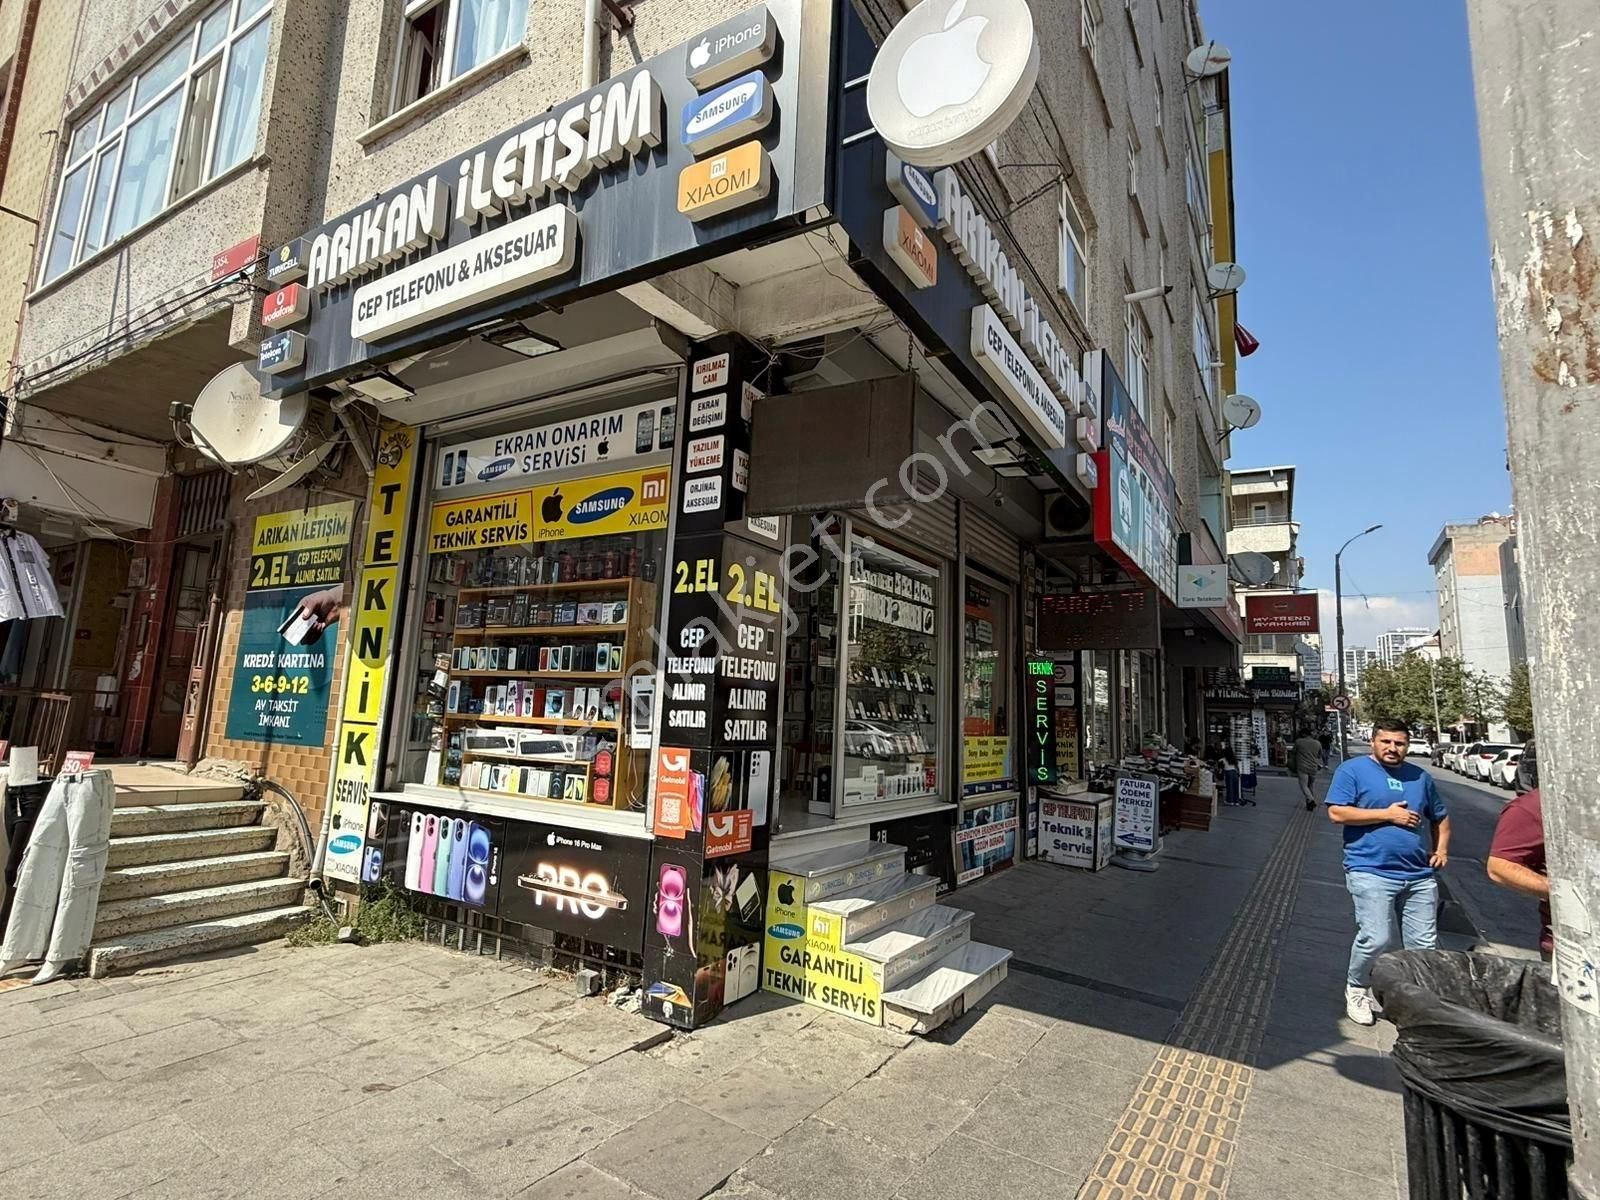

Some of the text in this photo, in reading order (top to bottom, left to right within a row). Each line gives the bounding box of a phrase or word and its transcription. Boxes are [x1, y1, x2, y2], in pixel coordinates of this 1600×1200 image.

[714, 22, 762, 53] iPhone
[694, 89, 749, 124] SAMSUNG
[685, 168, 752, 208] XIAOMI
[307, 175, 439, 289] ARIKAN
[902, 231, 935, 282] XIAOMI
[269, 256, 299, 278] TURKCELL
[357, 223, 558, 322] CEP TELEFONU & AKSESUAR
[263, 304, 295, 324] vodafone
[695, 358, 726, 375] KIRILMAZ
[987, 324, 1003, 356] CEP
[1003, 343, 1035, 400] TELEFONU
[702, 373, 718, 385] CAM
[697, 398, 720, 412] EKRAN
[692, 411, 723, 427] DEĞİŞİMİ
[495, 413, 624, 457] EKRAN ONARIM
[692, 439, 720, 454] YAZILIM
[689, 454, 721, 468] YÜKLEME
[575, 496, 626, 515] SAMSUNG
[686, 495, 719, 509] AKSESUAR
[445, 497, 518, 527] GARANTİLİ
[628, 509, 669, 527] XIAOM
[257, 514, 348, 548] ARIKAN İLETİŞİM
[433, 519, 528, 550] TEKNİK SERVİS
[538, 526, 565, 539] iPhone
[297, 546, 343, 566] CEP TELEFONU
[251, 554, 291, 588] 2.EL
[294, 566, 341, 585] ALINIR SATILIR
[674, 558, 719, 594] 2.EL
[726, 563, 780, 613] 2.EL
[680, 628, 705, 649] CEP
[737, 623, 764, 651] CEP
[243, 650, 325, 669] KREDİ KARTINA
[667, 657, 716, 674] TELEFONU
[720, 655, 777, 682] TELEFONU
[1028, 661, 1054, 675] TEKNİK
[251, 675, 310, 695] 3-6-9-12
[672, 683, 706, 701] ALINIR
[255, 696, 299, 713] AY TAKSİT
[728, 688, 767, 711] ALINIR
[258, 713, 291, 728] İMKANI
[668, 709, 706, 728] SATILIR
[724, 719, 767, 741] SATILIR
[335, 776, 369, 807] SERVİS
[1119, 780, 1152, 790] FATURA
[1121, 787, 1150, 799] ÖDEME
[1118, 797, 1153, 808] MERKEZİ
[1042, 820, 1084, 838] Teknik
[556, 836, 573, 847] iPhone
[581, 841, 591, 849] Pro
[591, 842, 603, 851] Max
[1053, 838, 1093, 855] Servis
[774, 906, 796, 919] iPhone
[771, 925, 801, 939] SAMSUNG
[805, 938, 837, 954] XIAOMI
[780, 945, 864, 985] GARANTİLİ
[766, 967, 876, 1019] TEKNİK SERVİS
